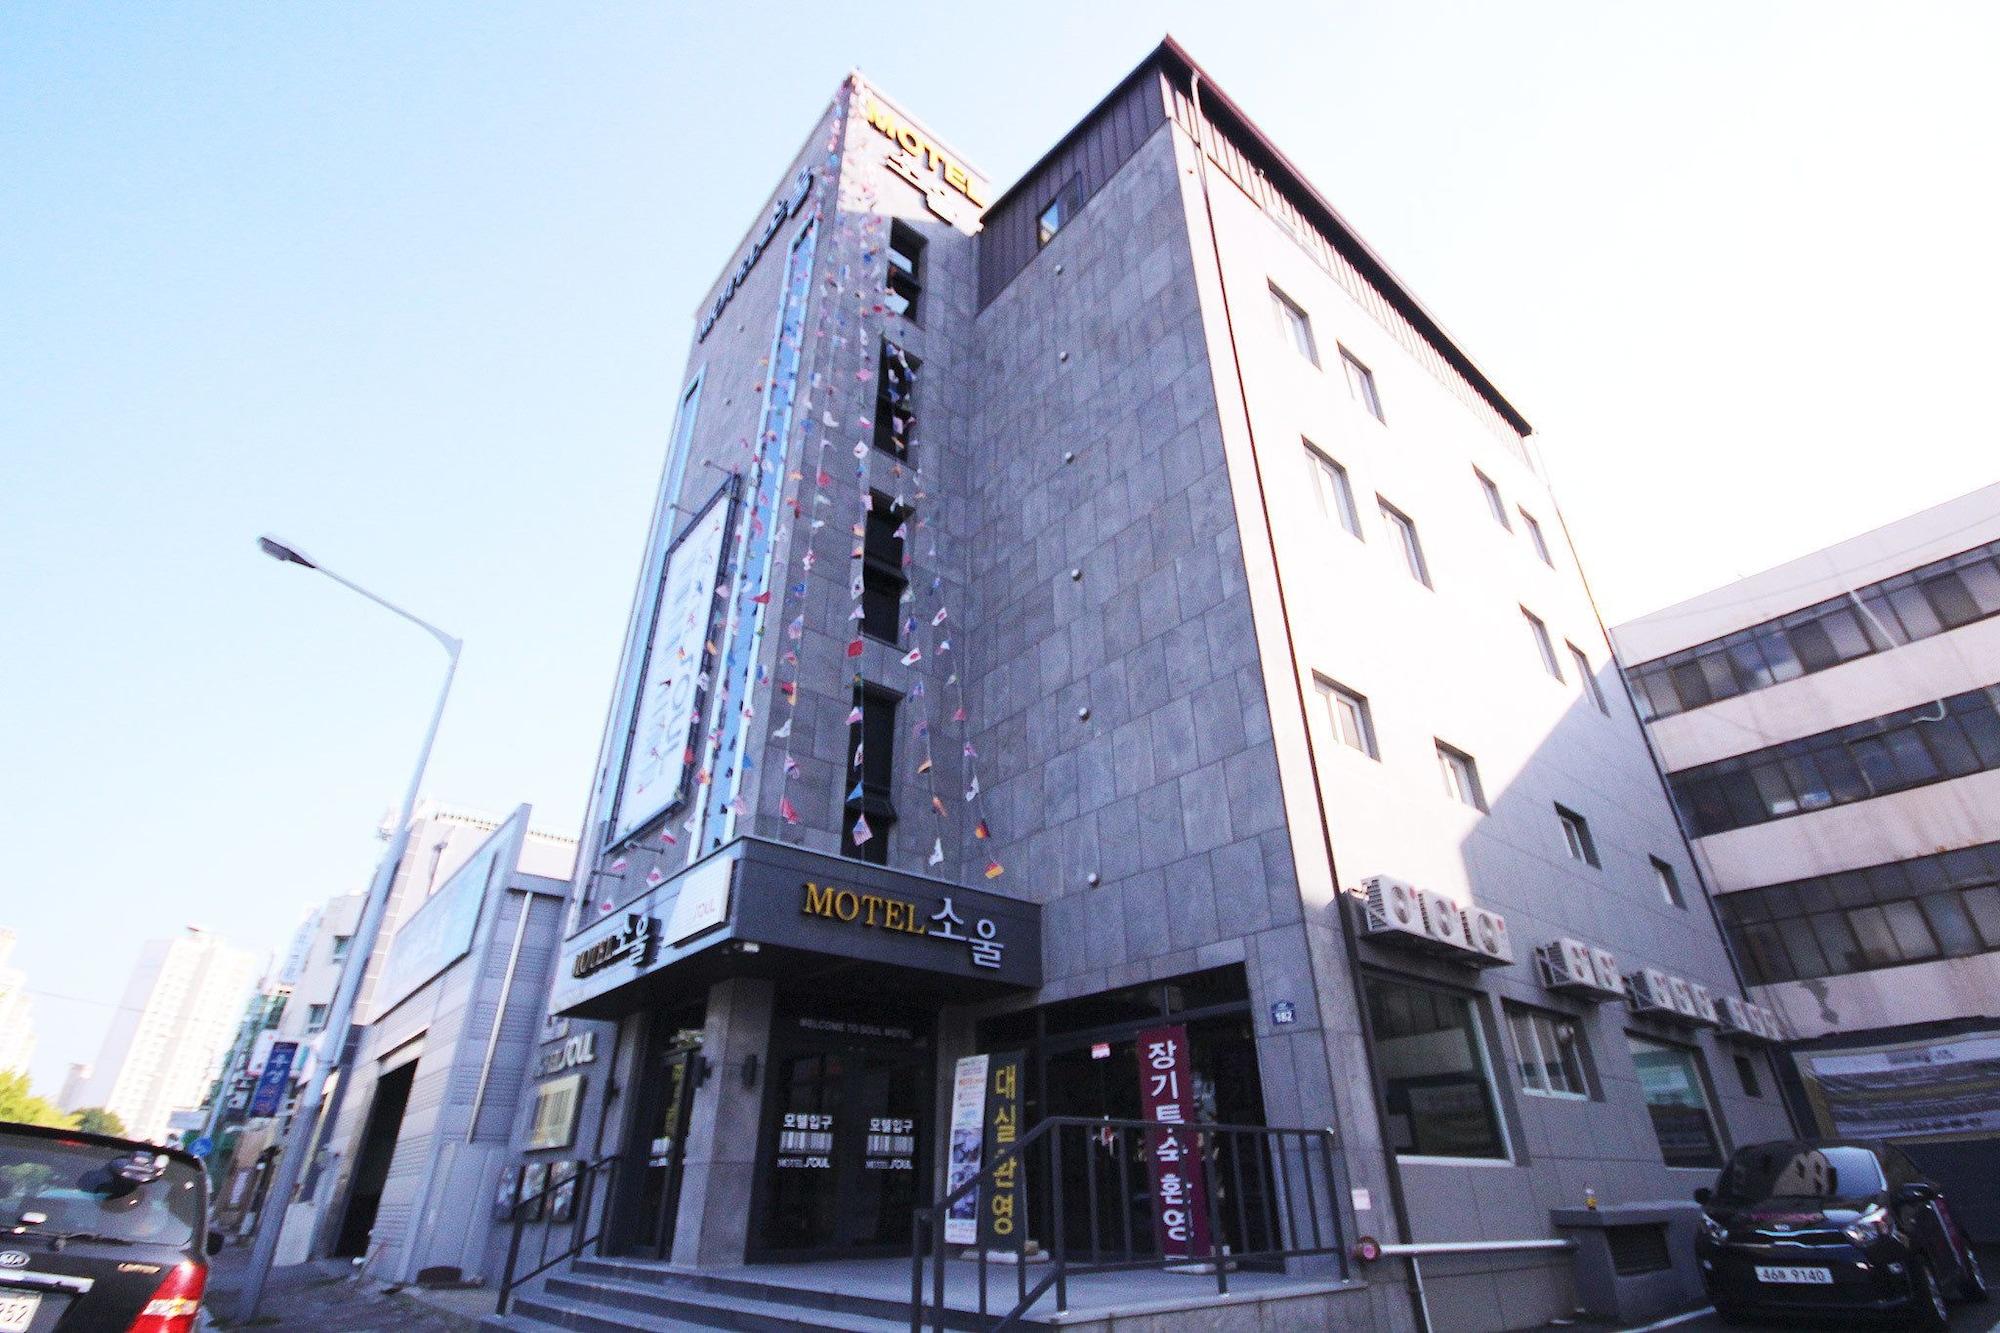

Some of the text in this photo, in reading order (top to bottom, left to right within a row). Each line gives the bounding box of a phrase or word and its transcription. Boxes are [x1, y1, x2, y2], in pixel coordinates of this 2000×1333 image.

[866, 99, 985, 209] MOTEL
[803, 882, 1004, 969] MOTEL 소울
[1791, 1268, 1825, 1281] 9140
